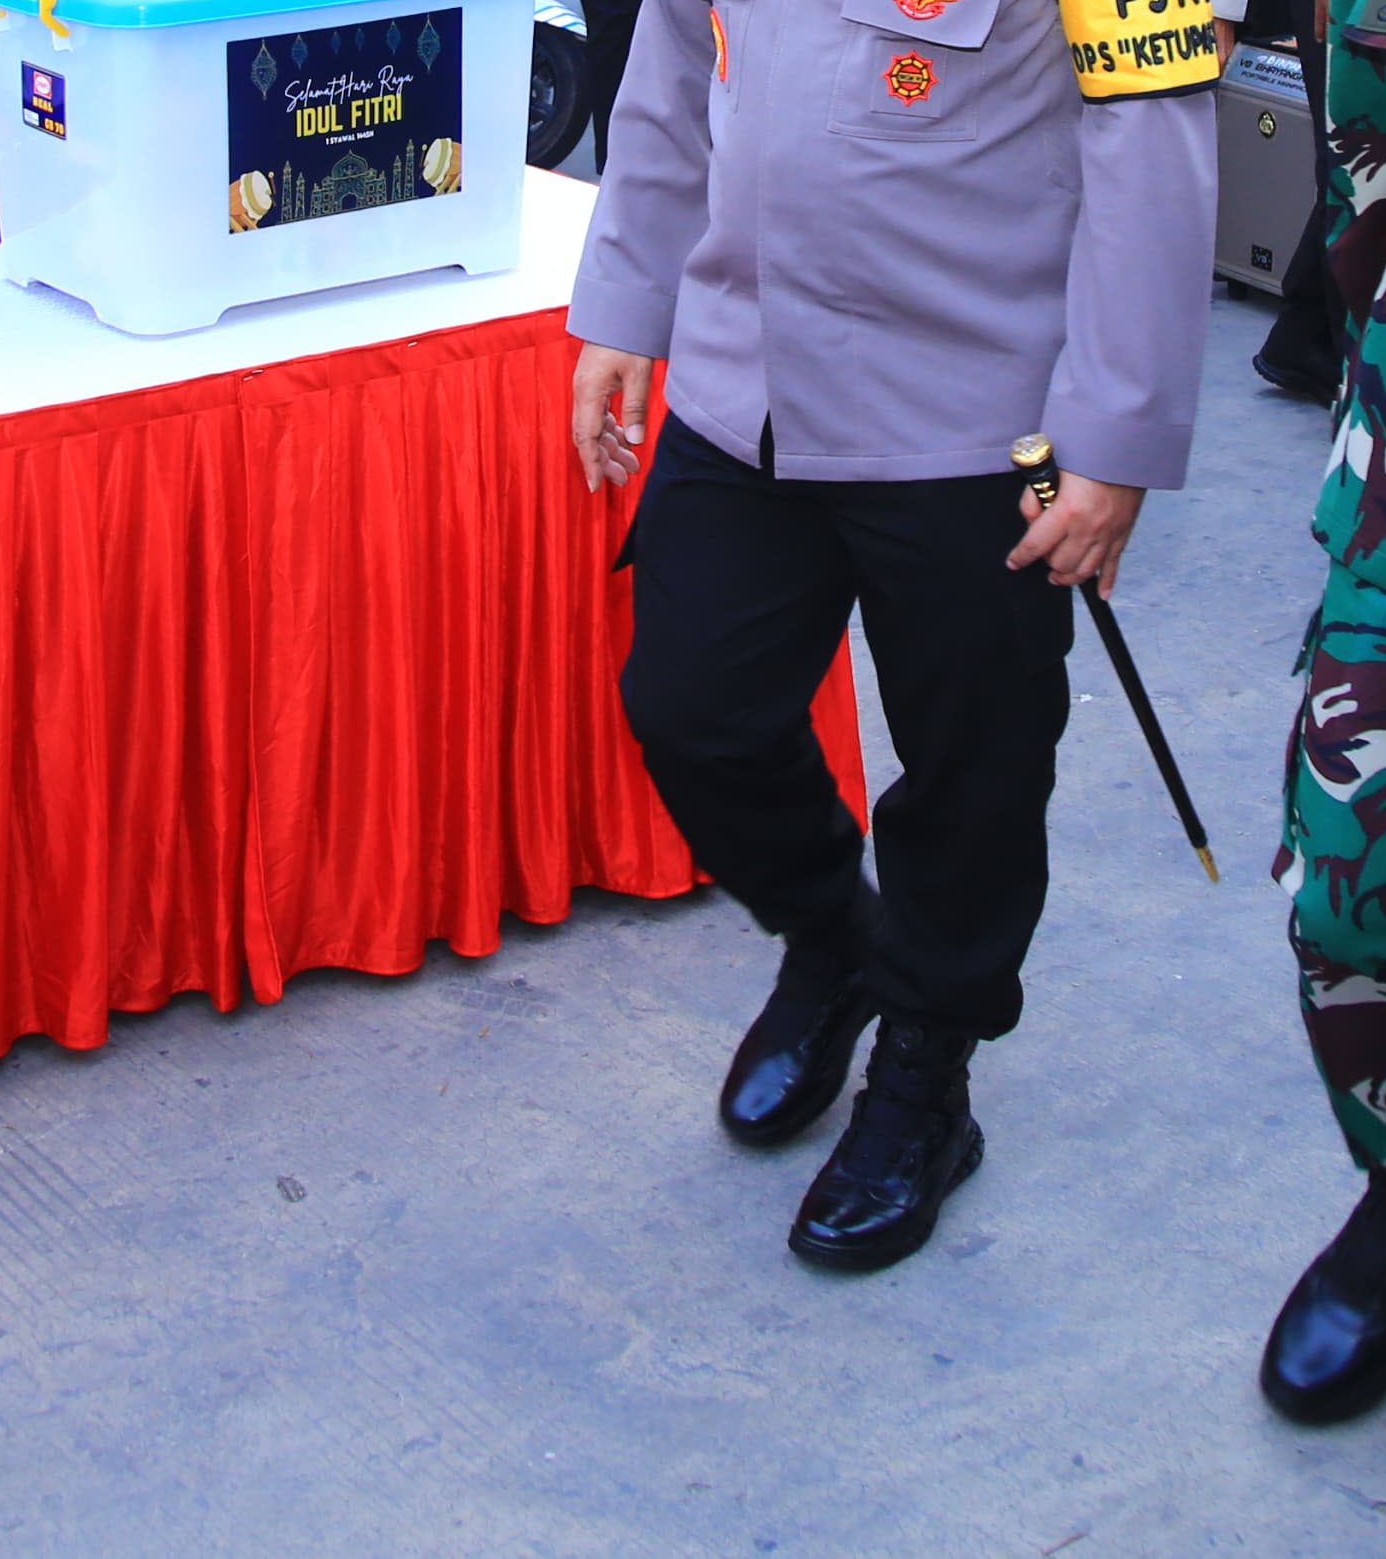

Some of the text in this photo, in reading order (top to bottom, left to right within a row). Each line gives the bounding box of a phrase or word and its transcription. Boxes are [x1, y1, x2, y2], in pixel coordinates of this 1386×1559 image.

[1072, 41, 1117, 74] OPS
[285, 64, 413, 113] Selamat Hari Raya
[296, 94, 402, 138] IDUL FITRI
[329, 133, 355, 145] SYAWAL
